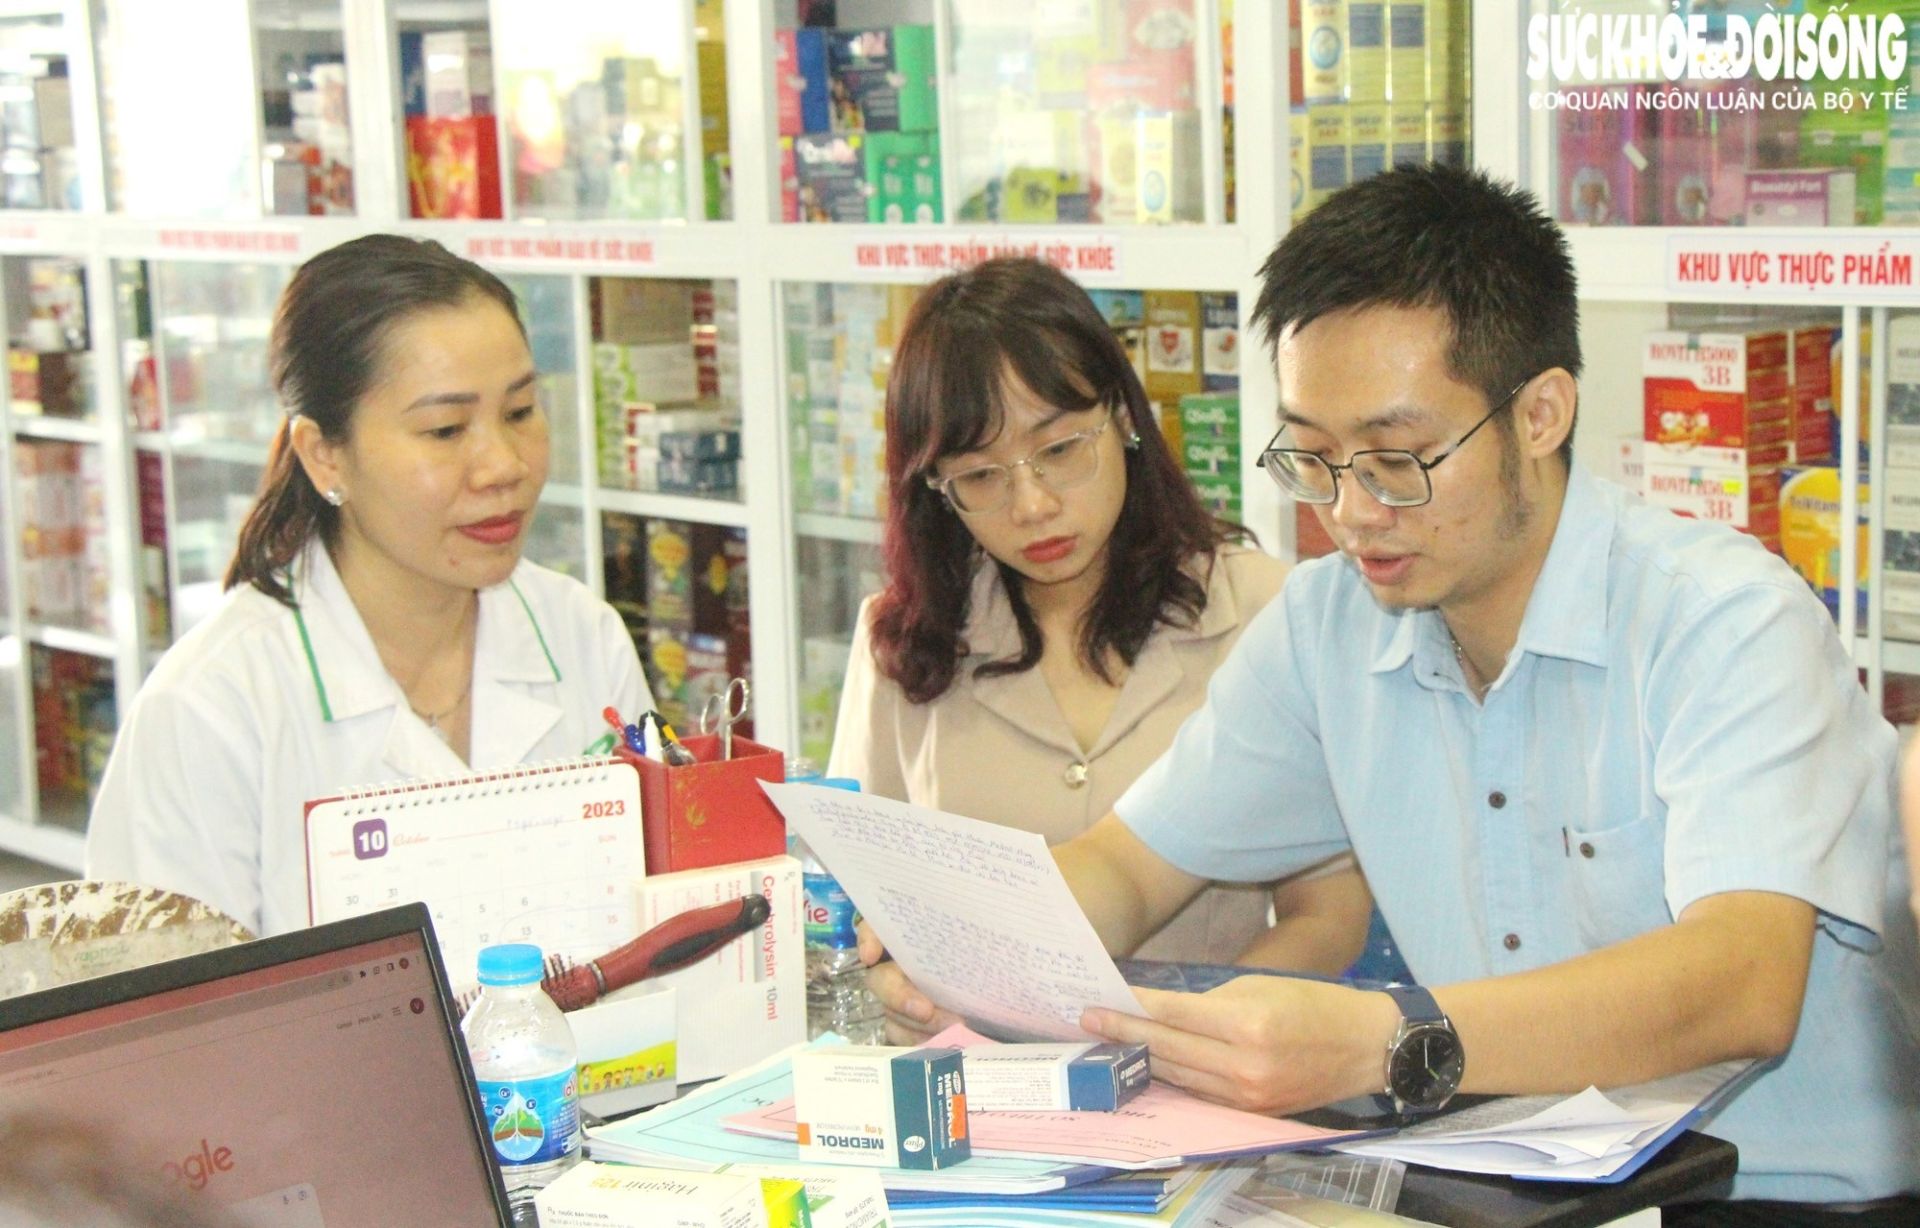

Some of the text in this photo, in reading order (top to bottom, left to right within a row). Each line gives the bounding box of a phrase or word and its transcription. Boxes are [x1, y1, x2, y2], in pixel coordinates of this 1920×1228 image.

[857, 243, 883, 266] KHU
[1678, 241, 1912, 291] KHU VỰC THỰC PHẨM
[1703, 366, 1731, 386] 3B
[1704, 498, 1734, 519] 3B
[582, 800, 625, 819] 2023
[358, 830, 386, 853] 10
[345, 888, 399, 906] 30 31
[436, 912, 444, 920] 4
[479, 904, 486, 913] 5
[521, 897, 529, 907] 6
[480, 933, 489, 943] 12
[521, 927, 532, 937] 13
[607, 914, 619, 925] 15
[766, 987, 779, 1020] 10ml
[817, 1134, 885, 1150] MEDROL
[623, 1181, 699, 1196] Haginir
